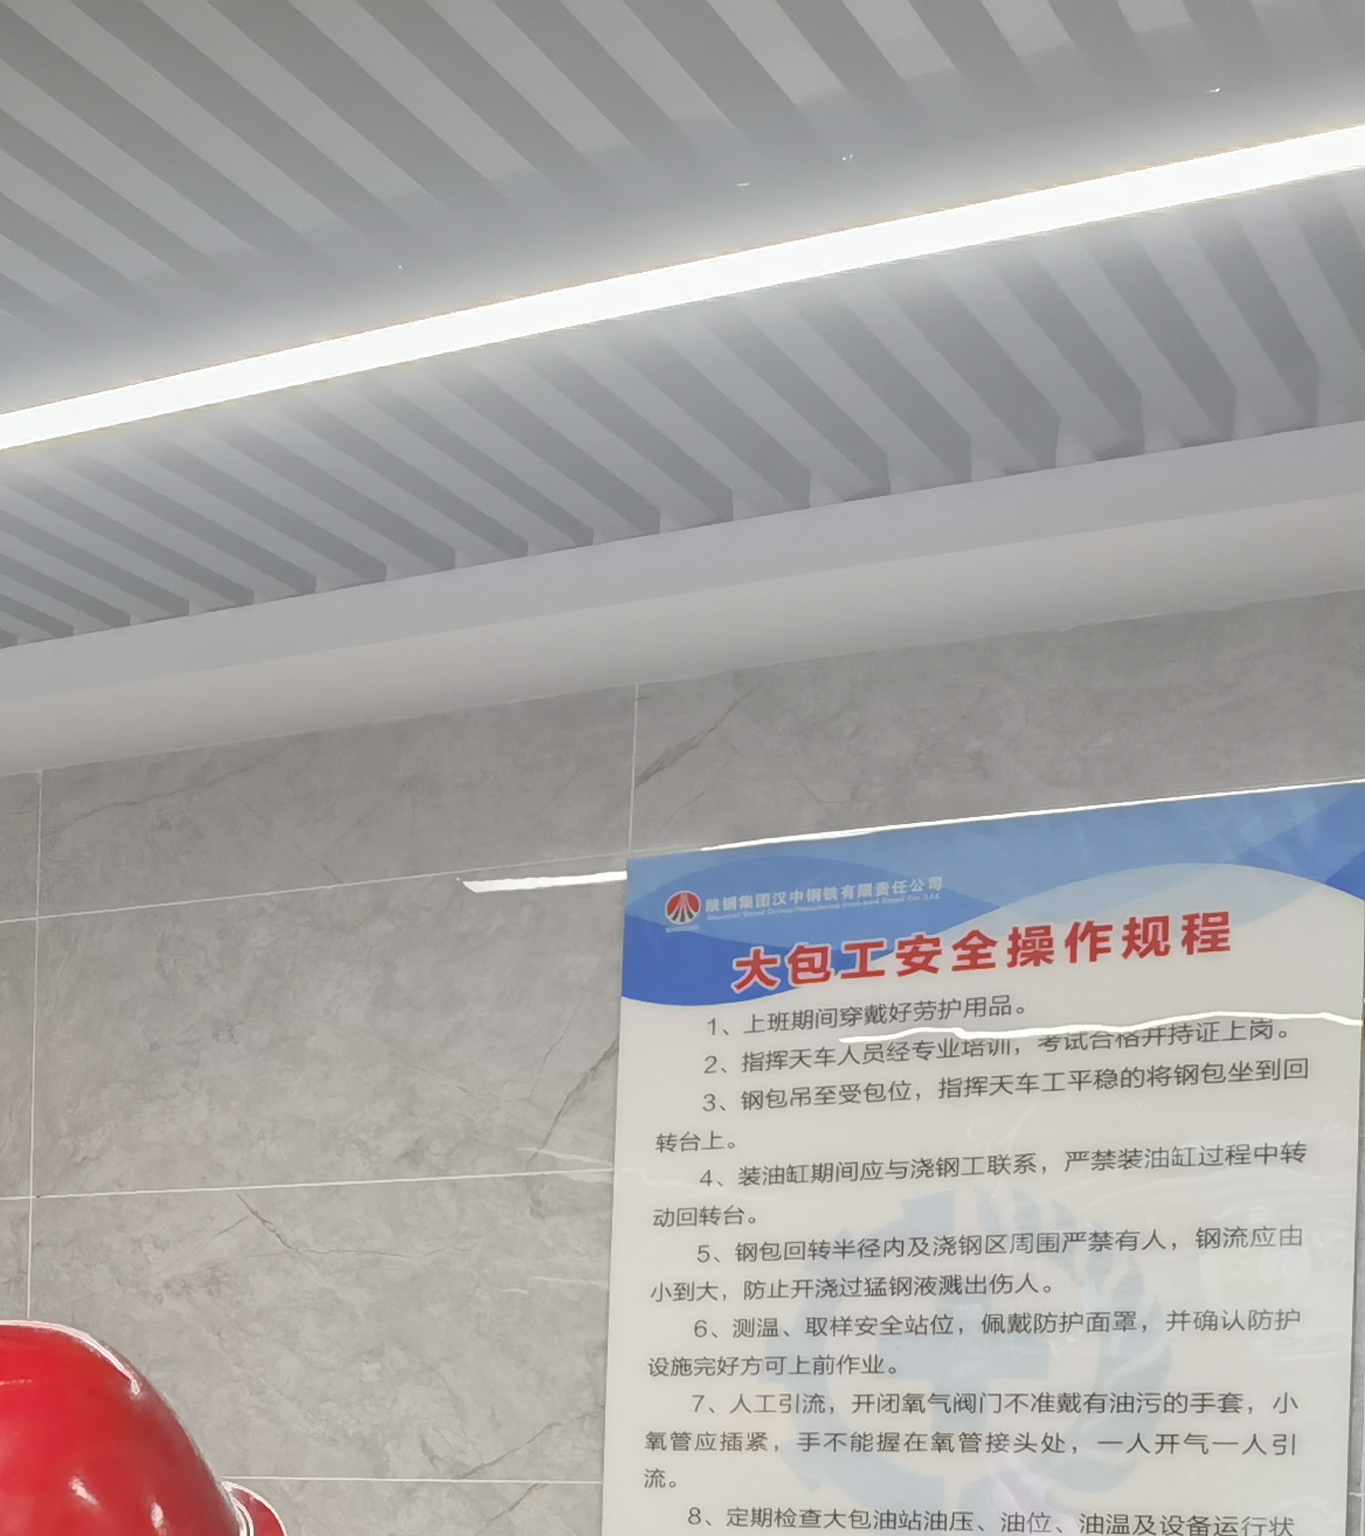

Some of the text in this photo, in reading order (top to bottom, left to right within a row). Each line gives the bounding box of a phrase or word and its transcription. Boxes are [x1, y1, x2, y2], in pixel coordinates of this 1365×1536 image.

[731, 909, 1232, 994] 大包工安全操作规程
[707, 996, 1026, 1038] 1、上班期间穿戴好劳护用品。
[703, 1057, 1309, 1114] 3、钢包吊至受包位，指挥天车工平稳的将钢包坐到回
[655, 1130, 738, 1154] 转台上。
[699, 1141, 1307, 1189] 4、装油缸期间应与浇钢工联系，严禁装油缸过程中转
[652, 1206, 757, 1230] 动回转台。
[696, 1225, 1303, 1265] 5、钢包回转半径内及浇钢区周围严禁有人，钢流应由
[650, 1273, 1054, 1303] 小到大，防止开浇过猛钢液溅出伤人。
[693, 1309, 1301, 1340] 6、测温、取样安全站位，佩戴防护面罩，并确认防护
[647, 1354, 899, 1378] 设施完好方可上前作业。
[692, 1391, 1299, 1417] 7、人工引流，开闭氧气阀门不准戴有油污的手套，小
[644, 1429, 1298, 1456] 氧管应插紧，手不能握在氧管接头处，一人开气一人引
[643, 1468, 680, 1490] 流。
